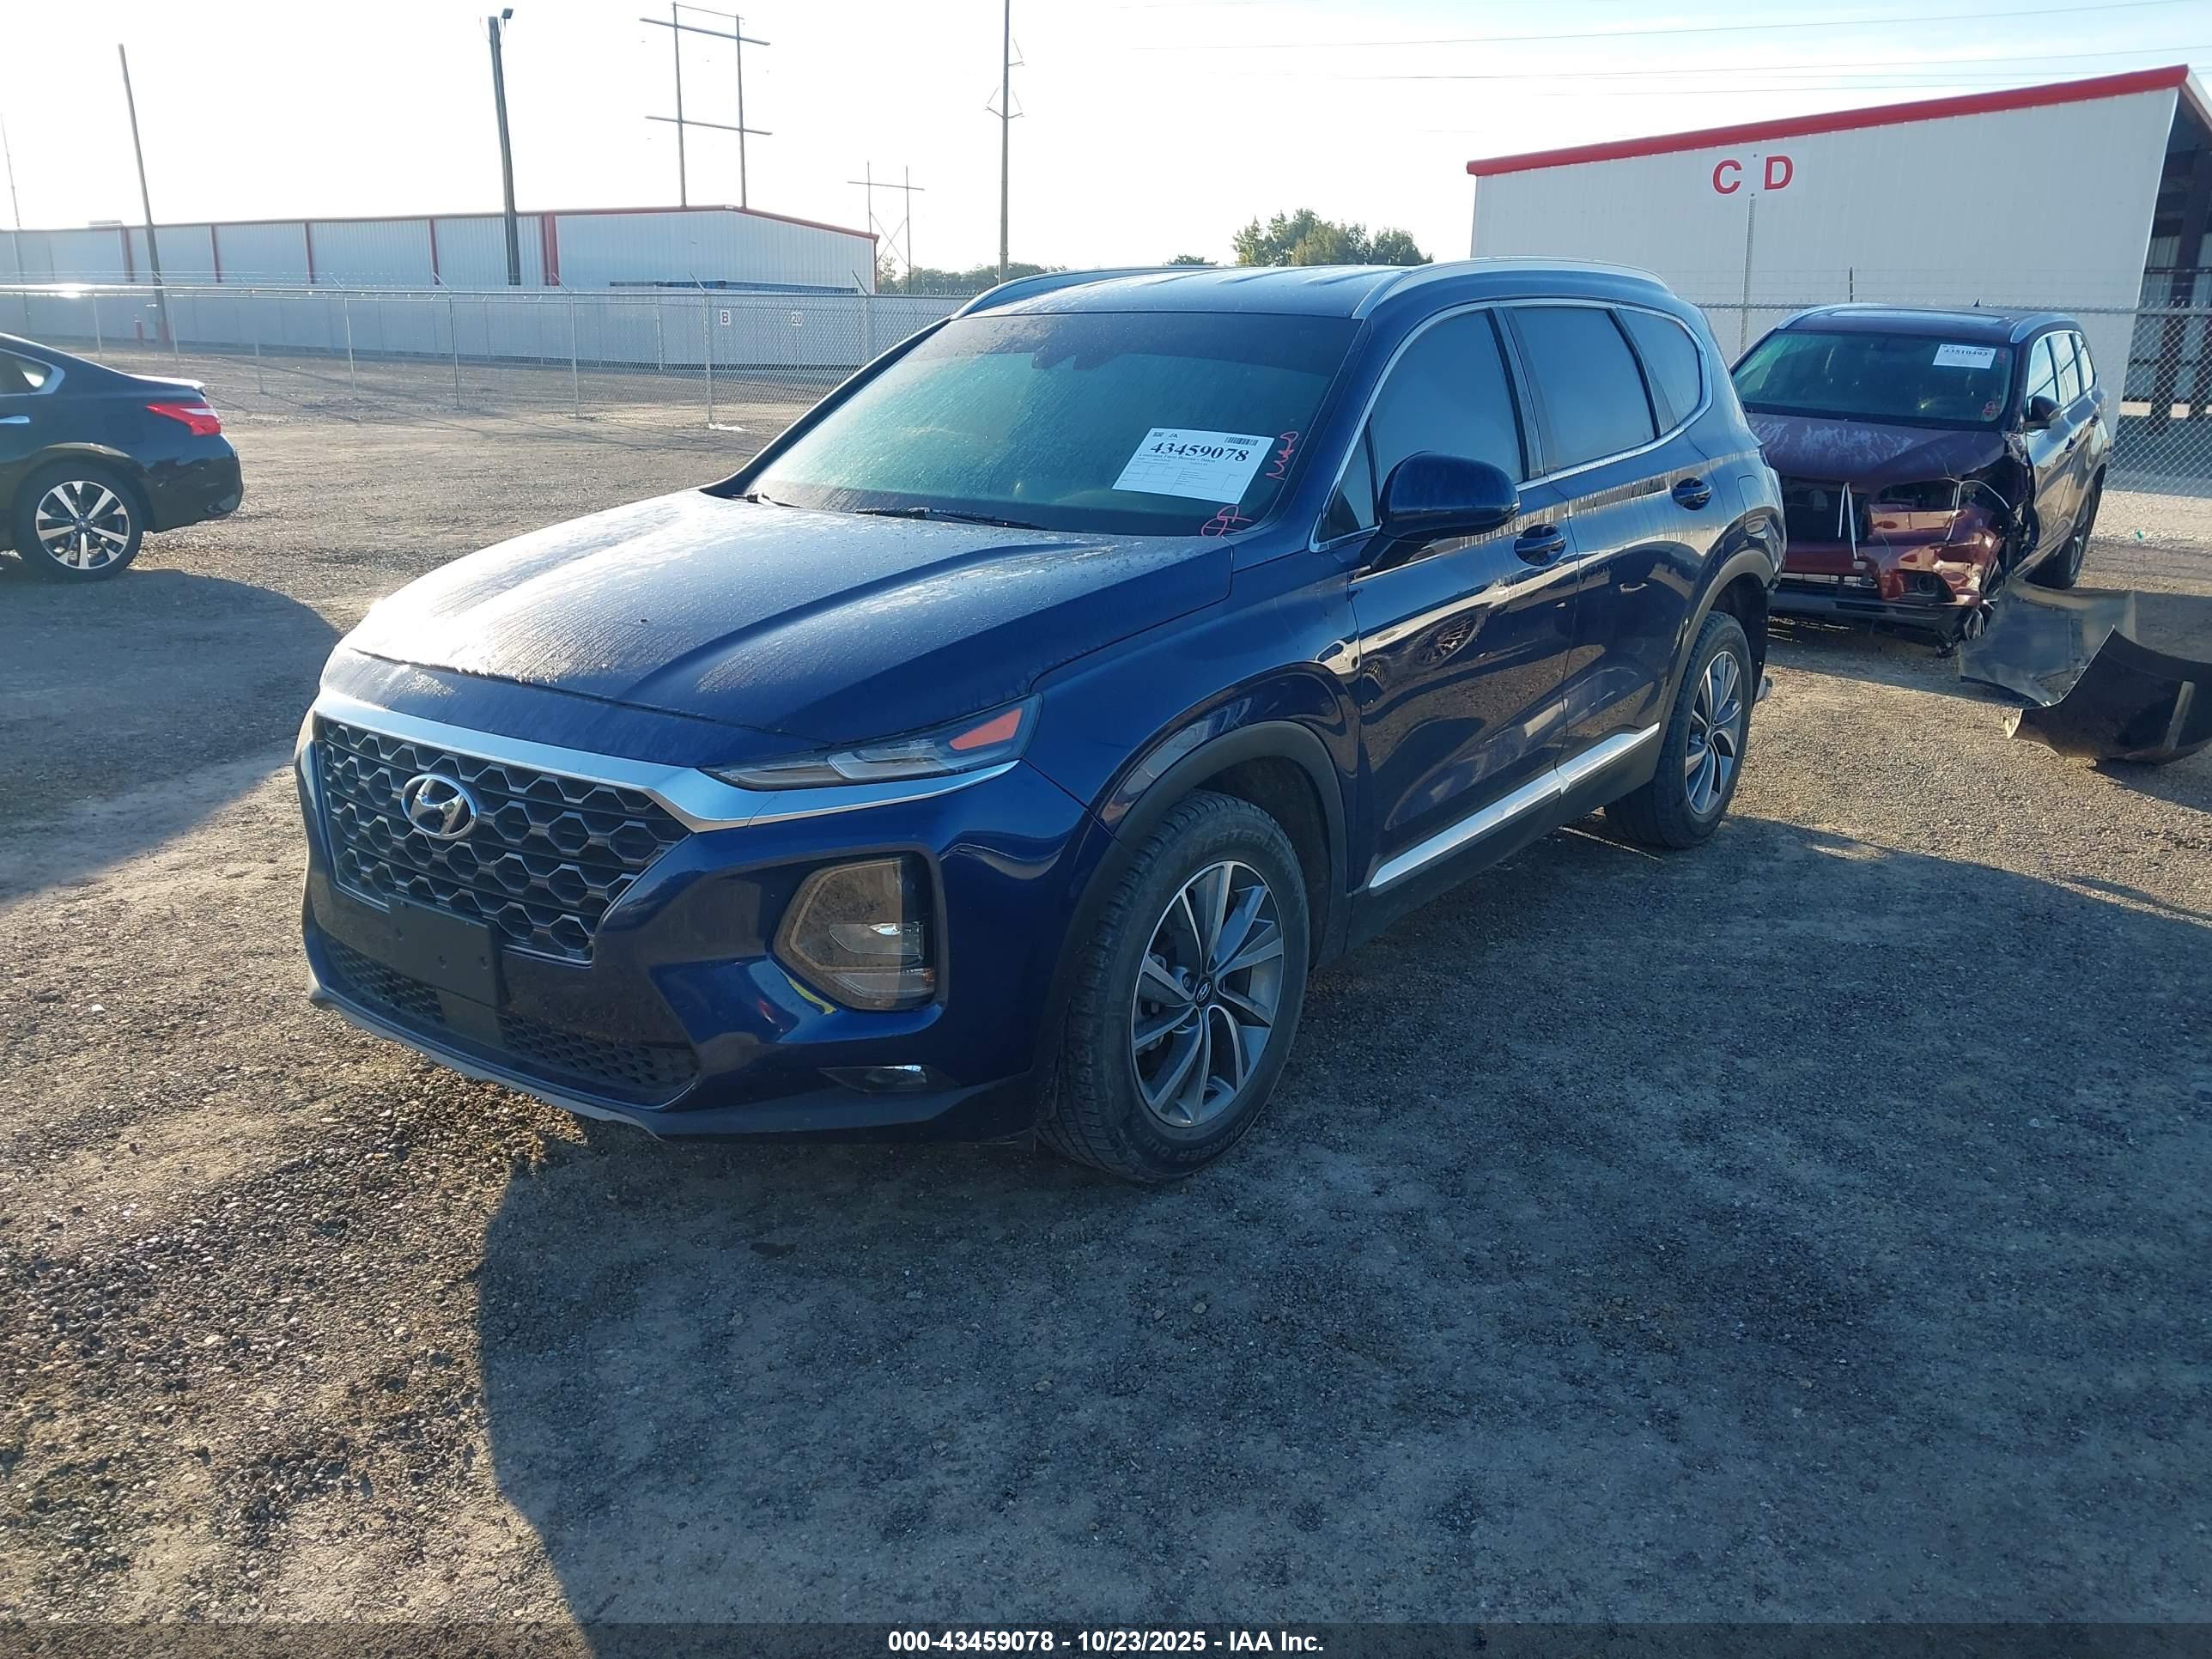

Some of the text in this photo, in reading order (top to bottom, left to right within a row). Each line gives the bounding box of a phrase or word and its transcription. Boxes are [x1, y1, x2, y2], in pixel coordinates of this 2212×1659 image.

[1712, 155, 1793, 194] C D
[721, 312, 730, 323] B
[792, 313, 802, 325] 20
[1151, 441, 1249, 462] 43459078
